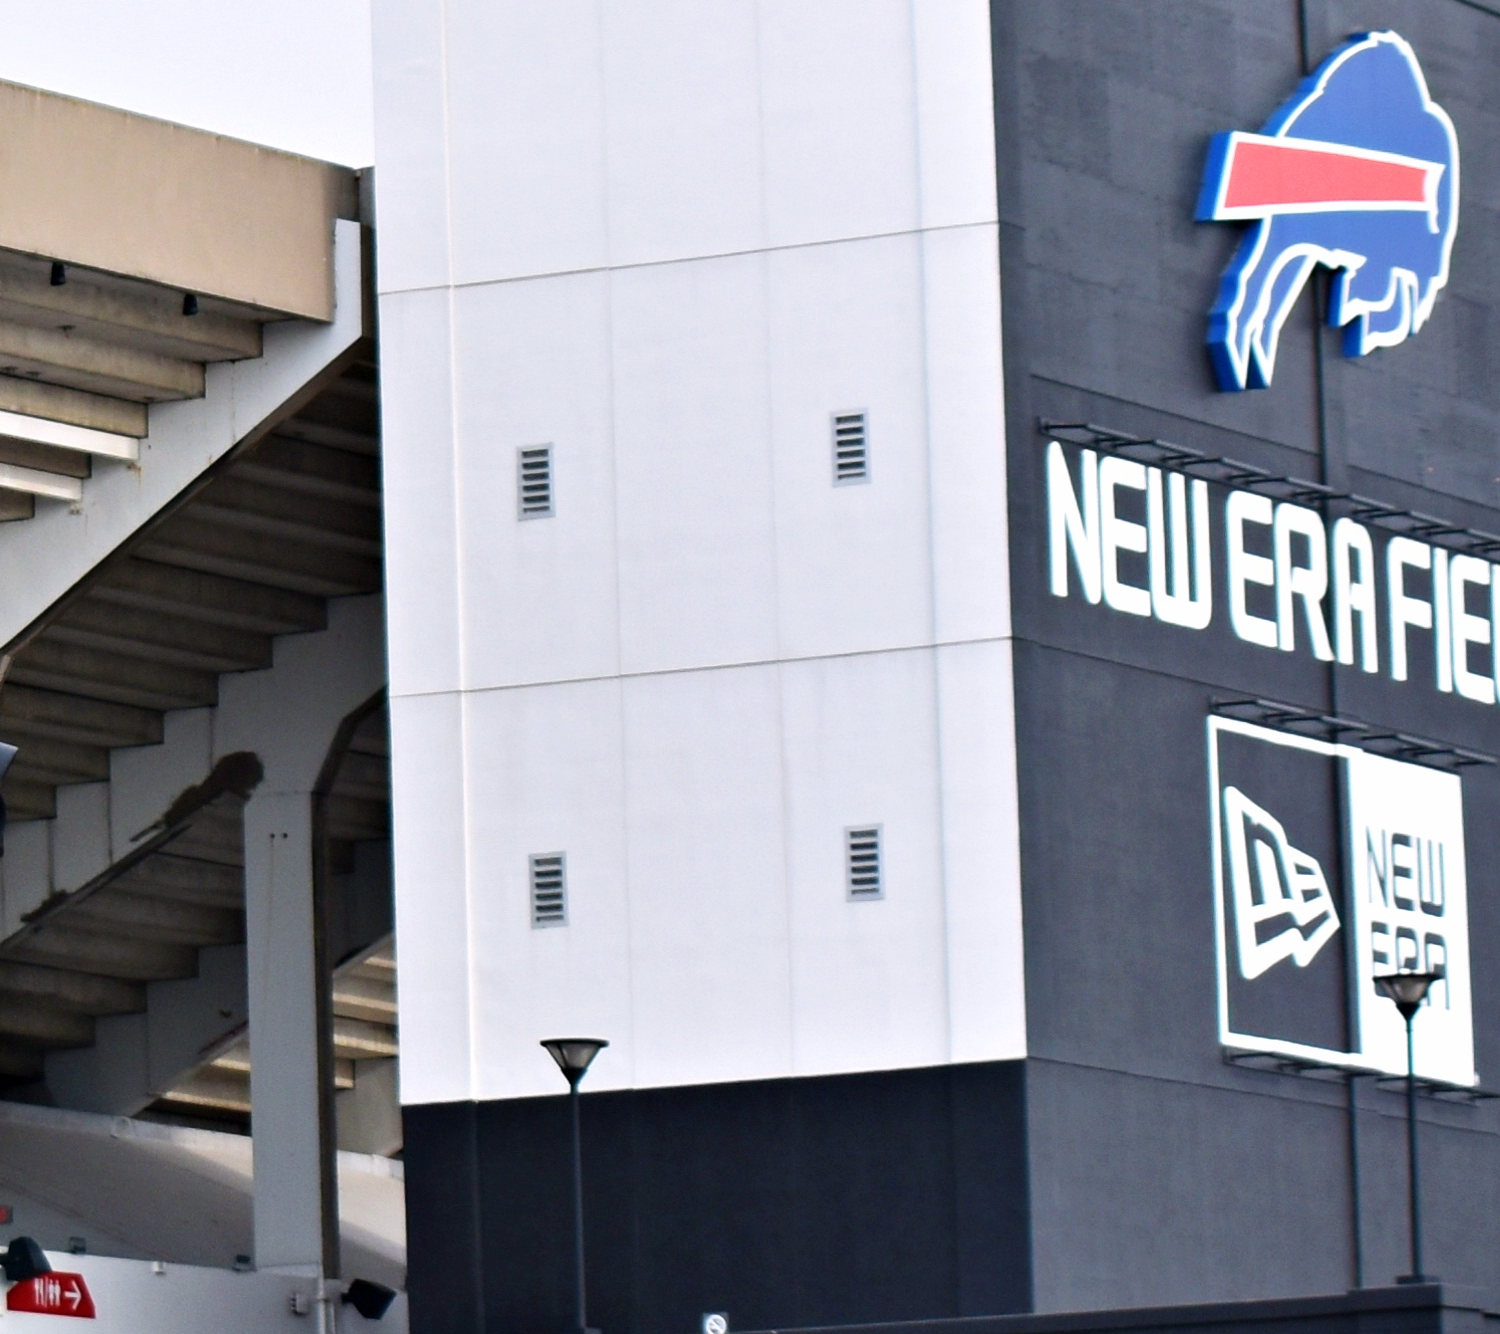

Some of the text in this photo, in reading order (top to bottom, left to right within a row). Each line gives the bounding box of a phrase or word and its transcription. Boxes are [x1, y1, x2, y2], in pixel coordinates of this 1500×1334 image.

[1047, 441, 1212, 631] NEW
[1227, 488, 1378, 674] ERA
[1366, 826, 1446, 918] NEW
